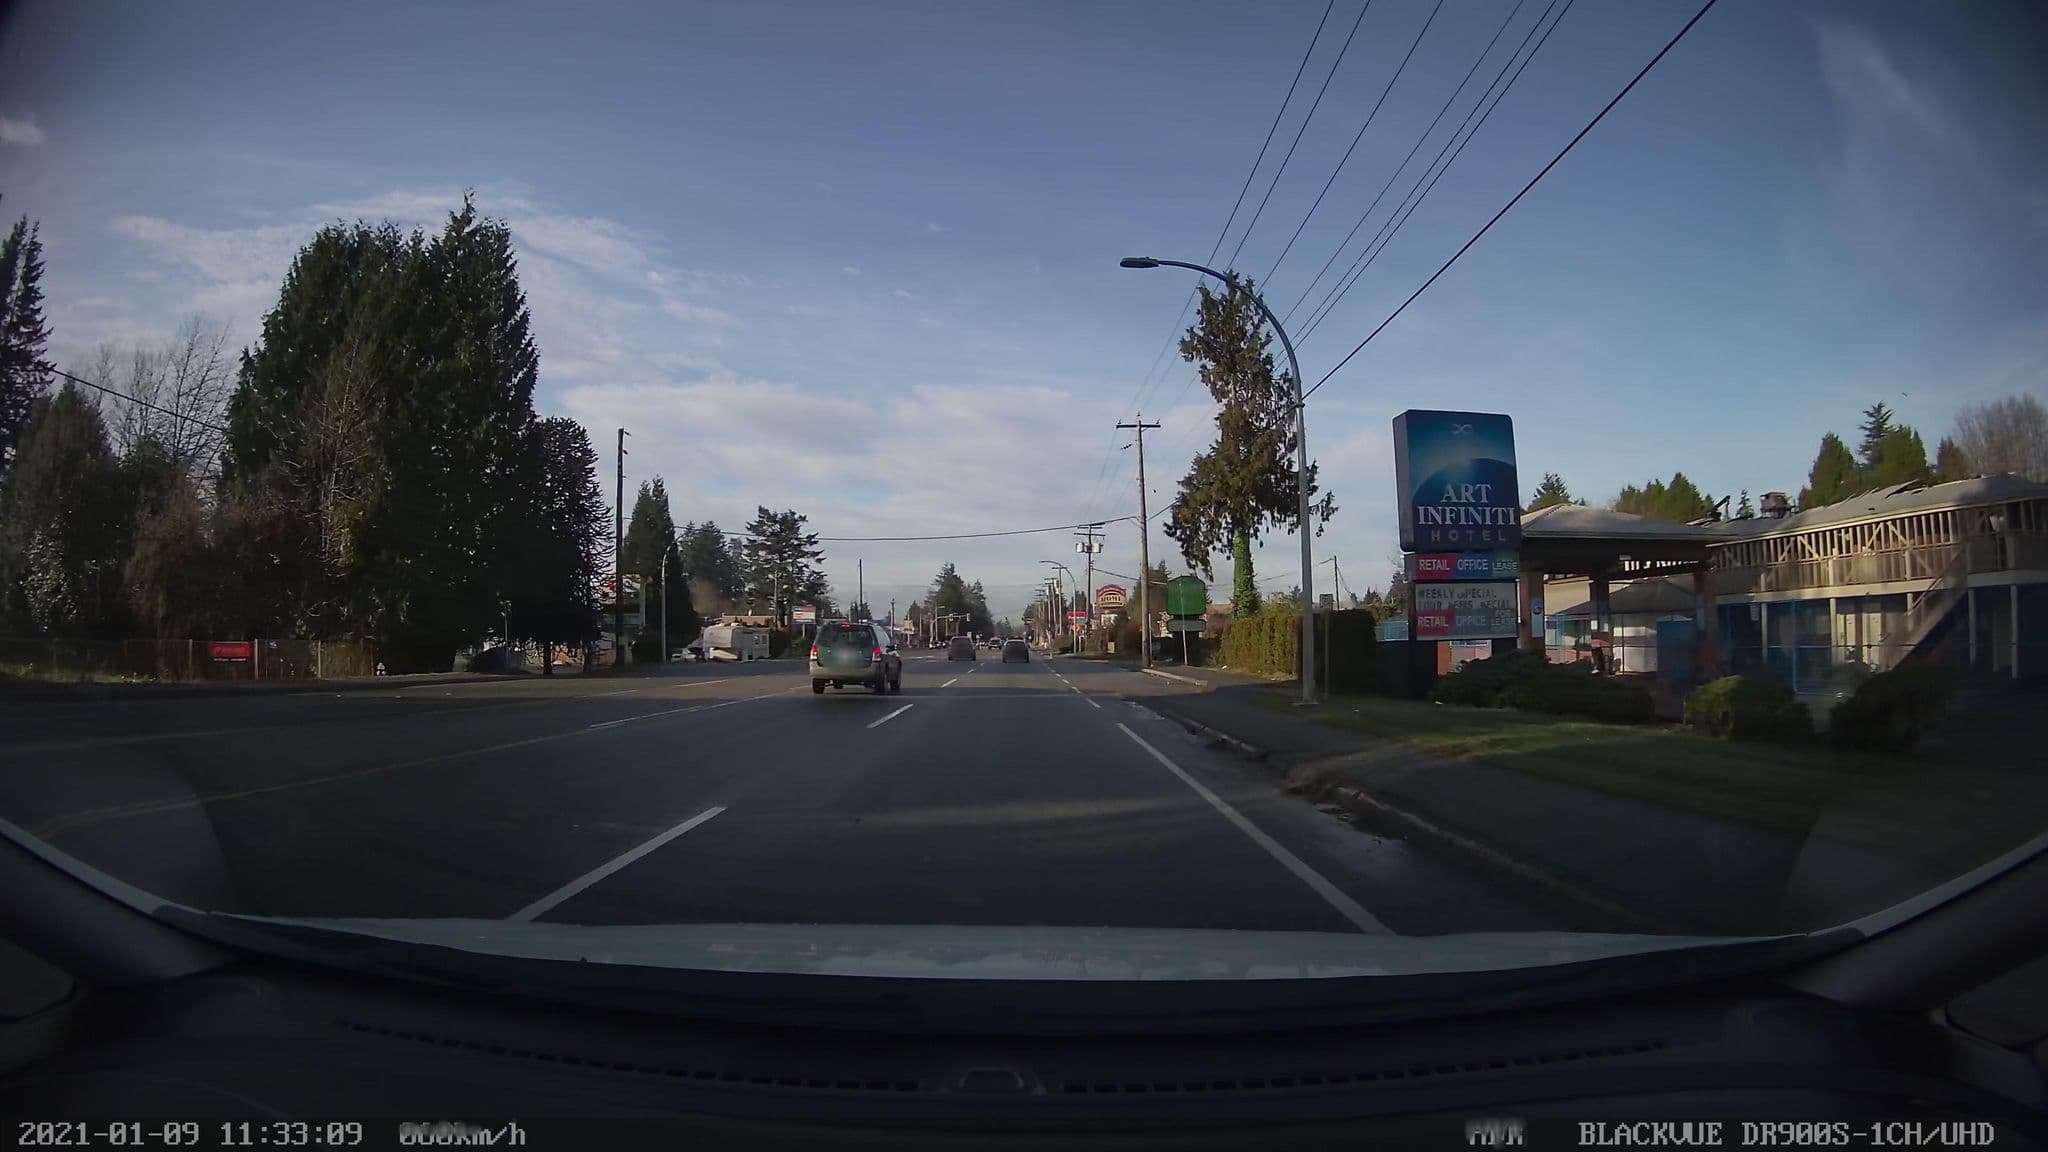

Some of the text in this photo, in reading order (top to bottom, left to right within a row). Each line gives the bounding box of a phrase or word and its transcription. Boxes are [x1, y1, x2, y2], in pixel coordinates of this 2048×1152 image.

[1440, 484, 1492, 503] ART
[1418, 507, 1516, 526] INFINITI
[1431, 530, 1506, 542] HOTEL
[1419, 559, 1450, 571] RETAIL
[1457, 559, 1488, 570] OFFICE
[1417, 616, 1449, 627] RETAIL
[1455, 616, 1487, 626] OFFICE
